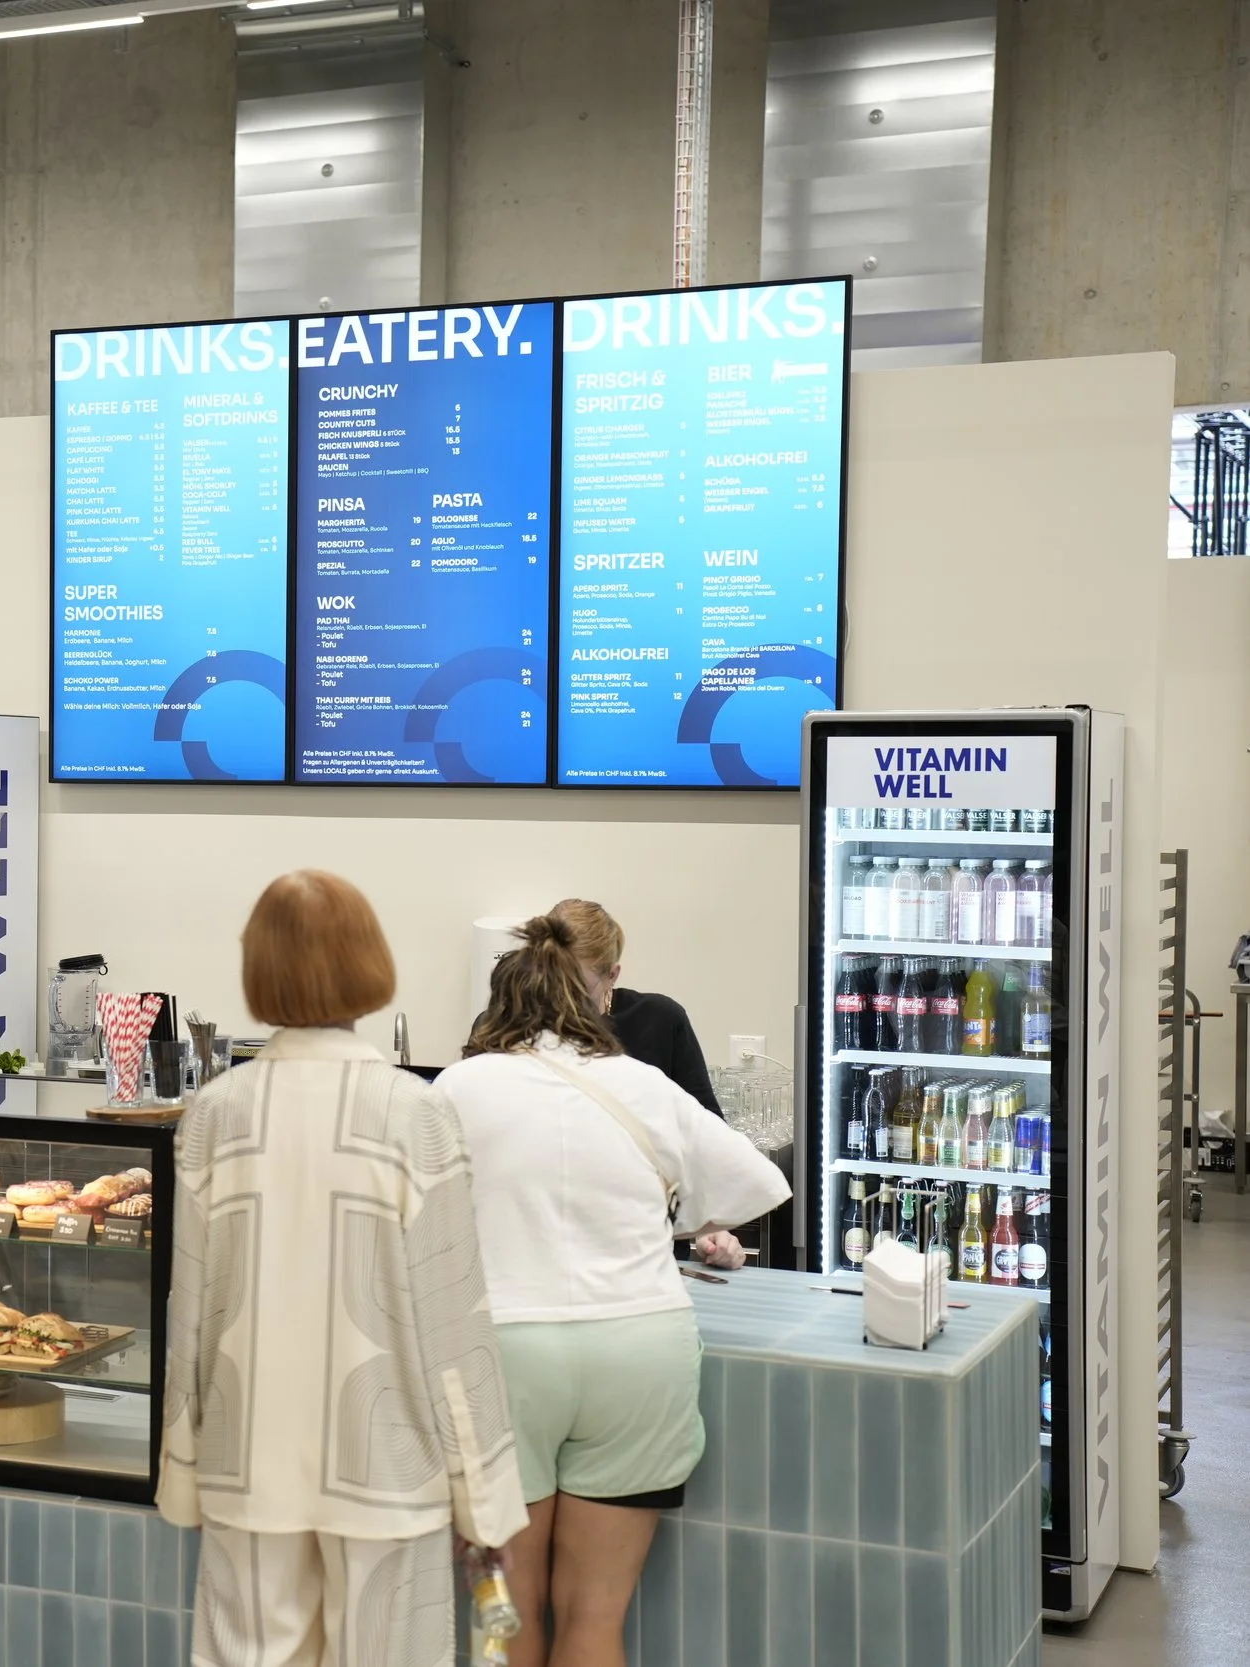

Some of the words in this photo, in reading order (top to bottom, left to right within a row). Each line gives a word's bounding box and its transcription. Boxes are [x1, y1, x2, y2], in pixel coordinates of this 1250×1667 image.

[564, 287, 844, 352] DRINKS.
[298, 304, 533, 368] EATERY.
[54, 322, 289, 381] DRINKS.
[708, 364, 751, 383] BIER
[577, 370, 648, 390] FRISCH
[649, 369, 667, 387] &
[319, 384, 399, 402] CRUNCHY
[184, 393, 250, 408] MINERAL
[251, 392, 264, 406] &
[575, 393, 664, 414] SPRITZIG
[67, 401, 119, 415] KAFFEE
[119, 400, 132, 413] &
[133, 399, 158, 413] TEE
[455, 403, 460, 412] 6
[183, 410, 278, 427] SOFTDRINKS
[318, 409, 350, 419] POMMES
[351, 409, 376, 417] FRITES
[455, 415, 460, 423] 7
[318, 420, 354, 429] COUNTRY
[355, 420, 375, 428] CUTS
[318, 431, 340, 440] FISCH
[340, 429, 381, 439] KNUSPERLI
[387, 429, 406, 437] STÜCK
[318, 442, 352, 450] CHICKEN
[352, 441, 379, 450] WINGS
[384, 440, 400, 448] Stück
[318, 453, 348, 461] FALAFEL
[355, 452, 370, 460] Stück
[705, 451, 808, 467] ALKOHOLFREI
[318, 463, 349, 472] SAUCEN
[67, 487, 95, 495] MATCHA
[96, 486, 117, 494] LATTE
[318, 497, 366, 513] PINSA
[432, 493, 483, 508] PASTA
[413, 516, 421, 524] 19
[431, 515, 478, 524] BOLOGNESE
[527, 512, 537, 520] 22
[318, 518, 365, 527] MARGHERITA
[432, 522, 470, 530] Tomatensauce
[480, 521, 513, 529] Hackfleisch
[317, 540, 364, 549] PROSCIUTTO
[410, 538, 421, 546] 20
[431, 537, 455, 545] AGLIO
[431, 558, 478, 567] POMODORO
[573, 552, 665, 571] SPRITZER
[703, 549, 758, 567] WEIN
[317, 562, 346, 570] SPEZIAL
[411, 560, 421, 568] 22
[703, 576, 728, 584] PINOT
[729, 575, 761, 584] GRIGIO
[65, 585, 117, 600] SUPER
[573, 584, 599, 592] APERO
[600, 584, 628, 592] SPRITZ
[317, 596, 356, 610] WOK
[65, 605, 164, 621] SMOOTHIES
[573, 609, 597, 617] HUGO
[702, 605, 749, 615] PROSECCO
[316, 617, 332, 625] PAD
[320, 632, 343, 640] Poulet
[321, 641, 336, 649] Tofu
[702, 638, 725, 647] CAVA
[64, 650, 112, 658] BEERENGLÜCK
[571, 647, 669, 661] ALKOHOLFREI
[335, 655, 368, 663] GORENG
[702, 668, 725, 676] PAGO
[726, 668, 738, 676] DE
[738, 667, 756, 676] LOS
[571, 673, 602, 682] GLITTER
[603, 673, 631, 681] SPRITZ
[701, 677, 755, 685] CAPELLANES
[359, 696, 373, 704] MIT
[374, 696, 391, 704] REIS
[571, 693, 590, 701] PINK
[590, 693, 618, 701] SPRITZ
[320, 720, 336, 728] Tofu
[874, 748, 1007, 771] VITAMIN
[874, 775, 952, 798] WELL
